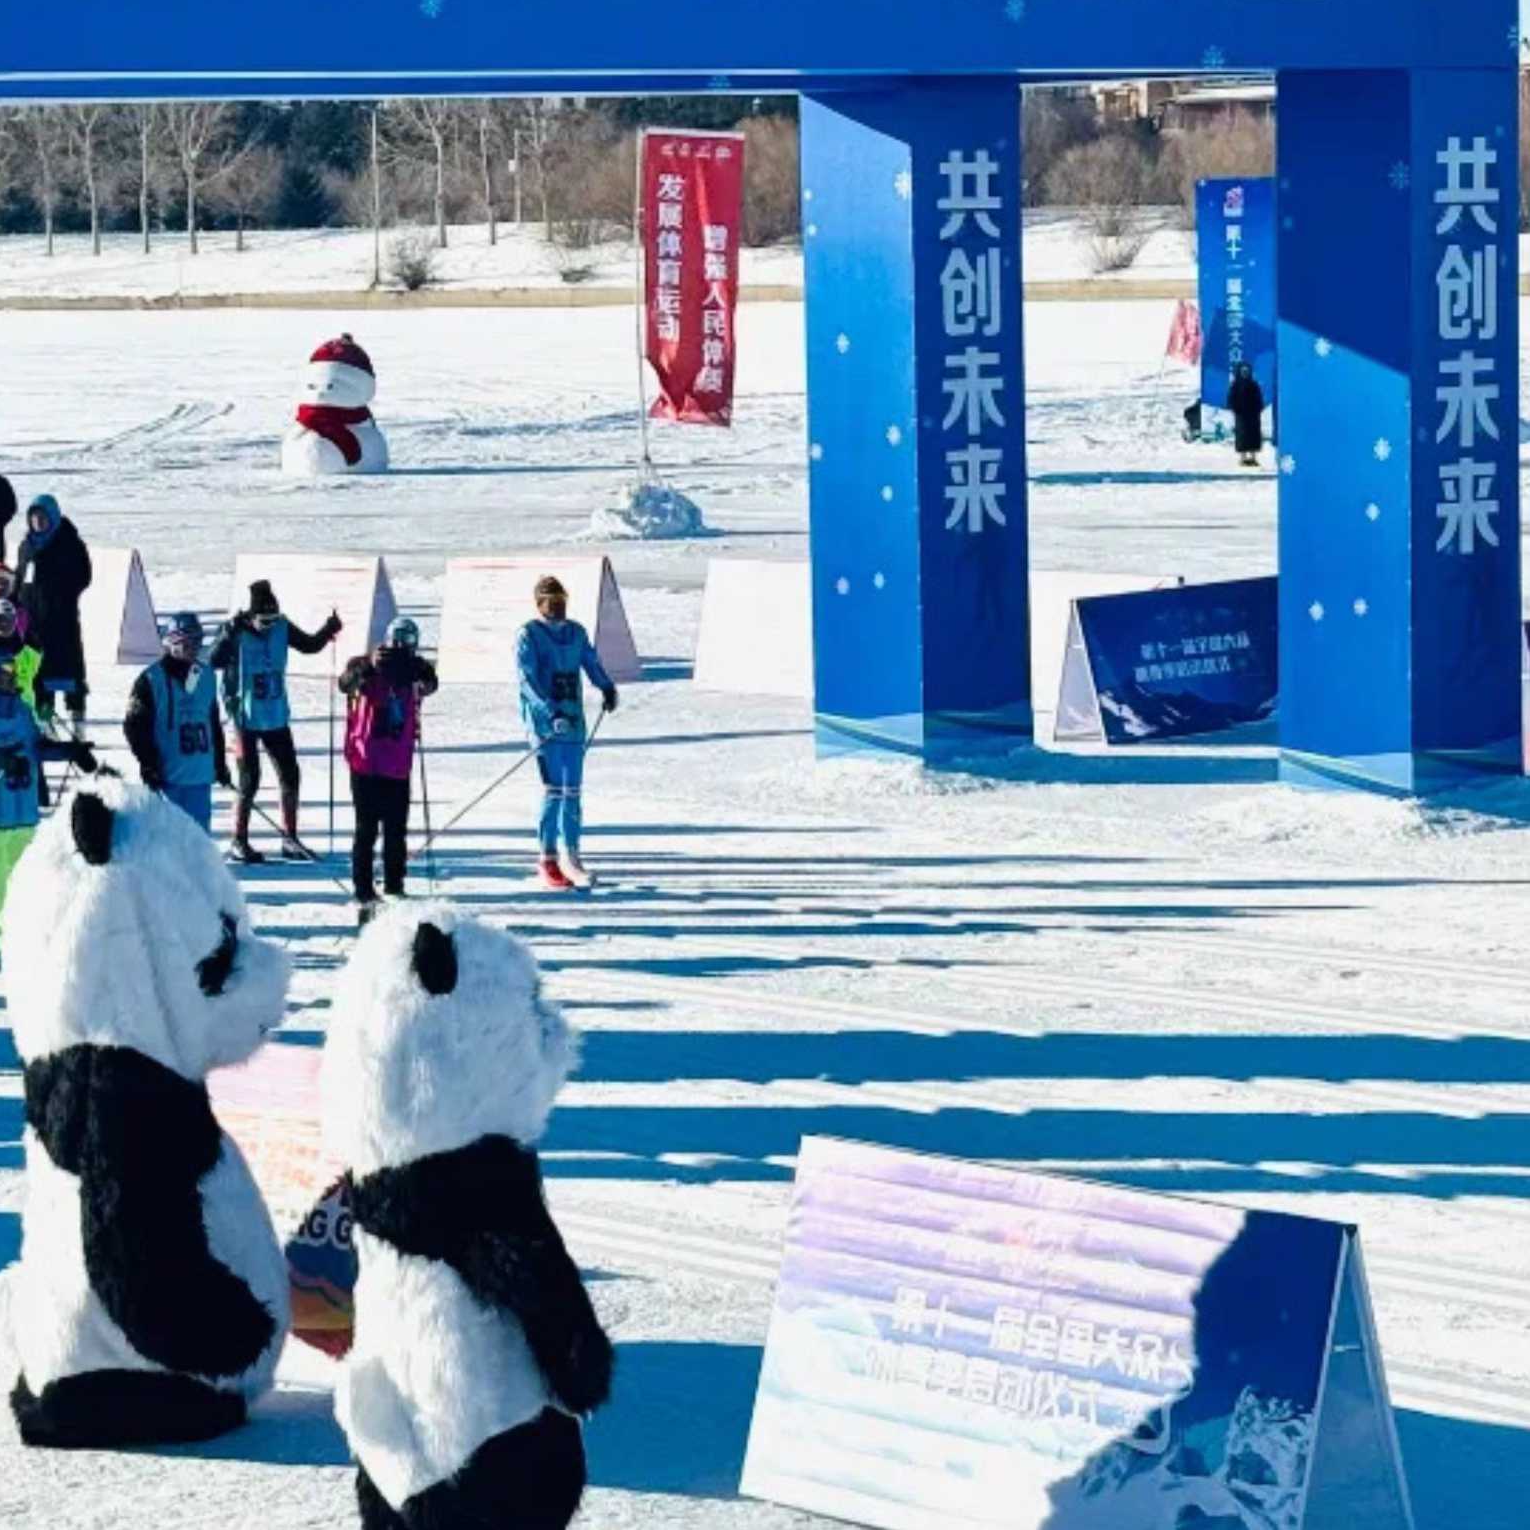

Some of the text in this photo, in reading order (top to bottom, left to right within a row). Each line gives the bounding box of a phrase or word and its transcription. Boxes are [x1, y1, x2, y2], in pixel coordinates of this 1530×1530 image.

[656, 173, 685, 342] 发展体育运动
[937, 149, 1007, 534] 共创未来
[1434, 136, 1500, 554] 共创未来
